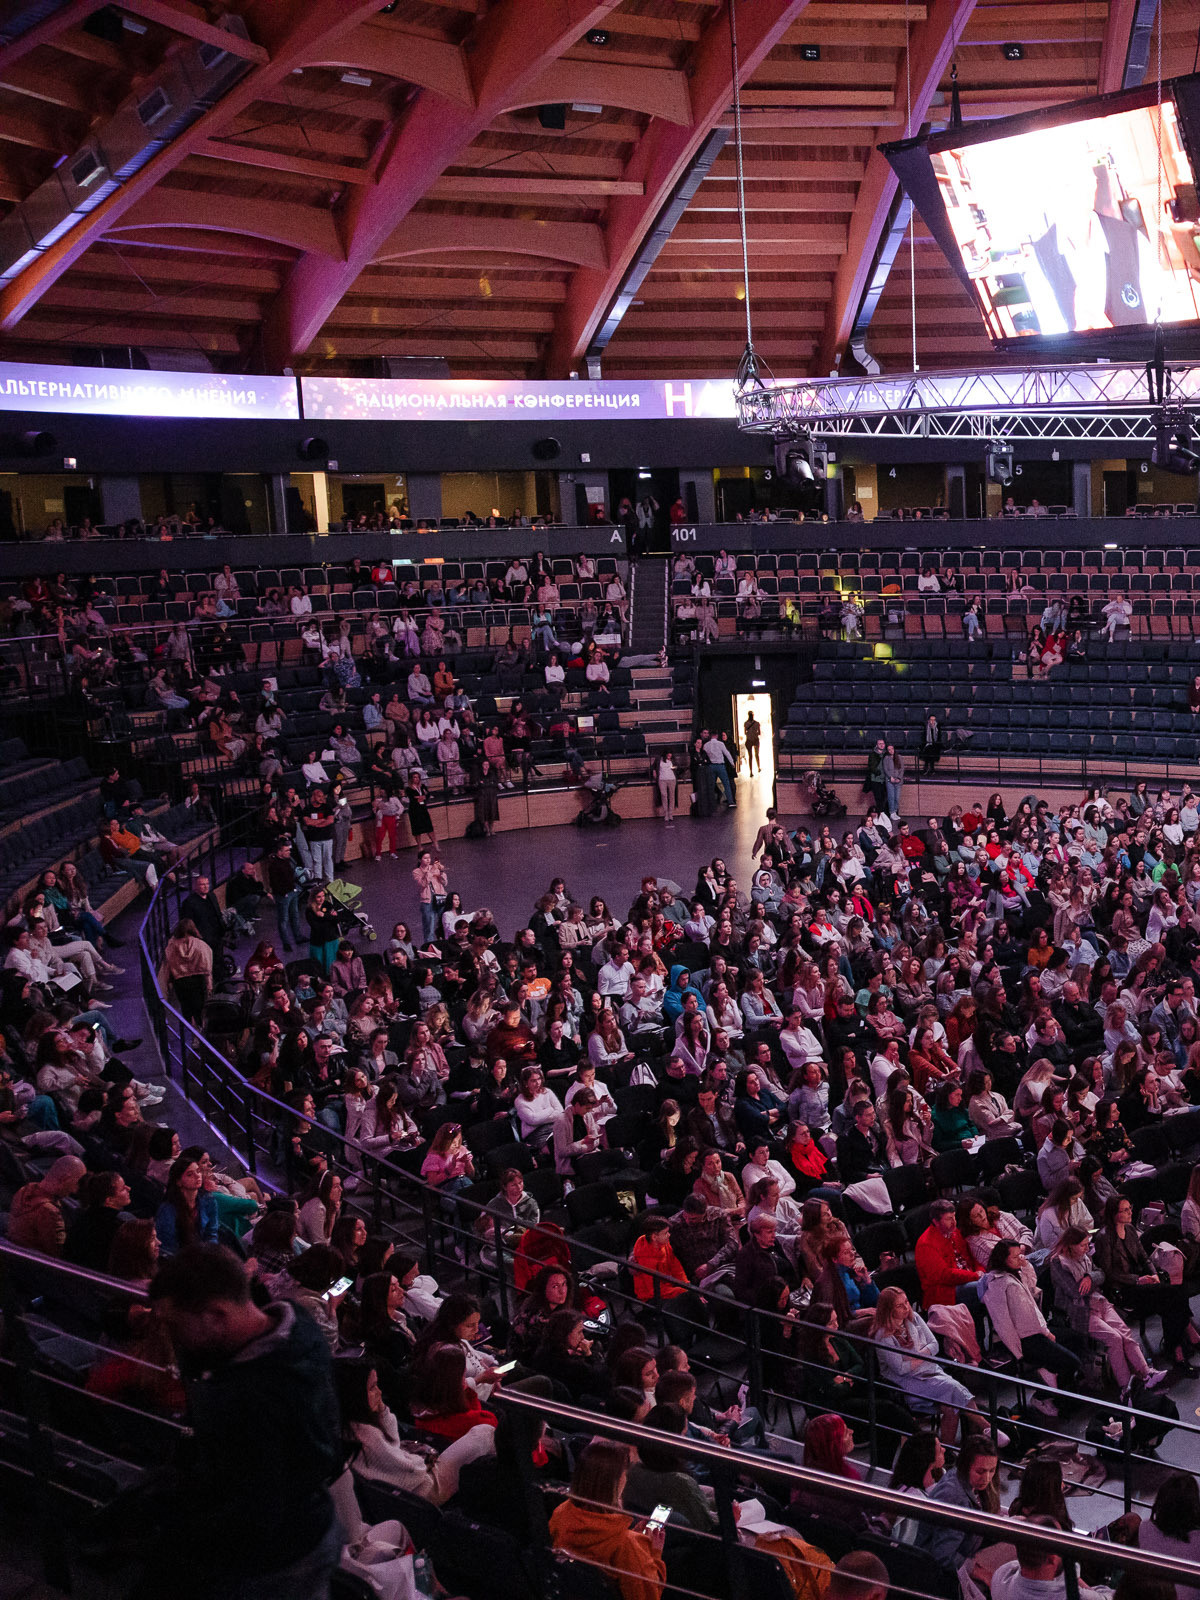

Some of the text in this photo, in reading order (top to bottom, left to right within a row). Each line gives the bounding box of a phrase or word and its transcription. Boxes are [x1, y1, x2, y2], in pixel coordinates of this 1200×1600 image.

[355, 392, 641, 408] НАЦИОНАЛЬНАЯ КОНФЕРЕНЦИЯ
[888, 467, 896, 478] 4
[1015, 464, 1023, 475] 5
[1140, 462, 1148, 473] 6
[764, 469, 772, 480] 3
[87, 478, 94, 490] 1
[395, 475, 404, 487] 2
[672, 528, 697, 541] 101
